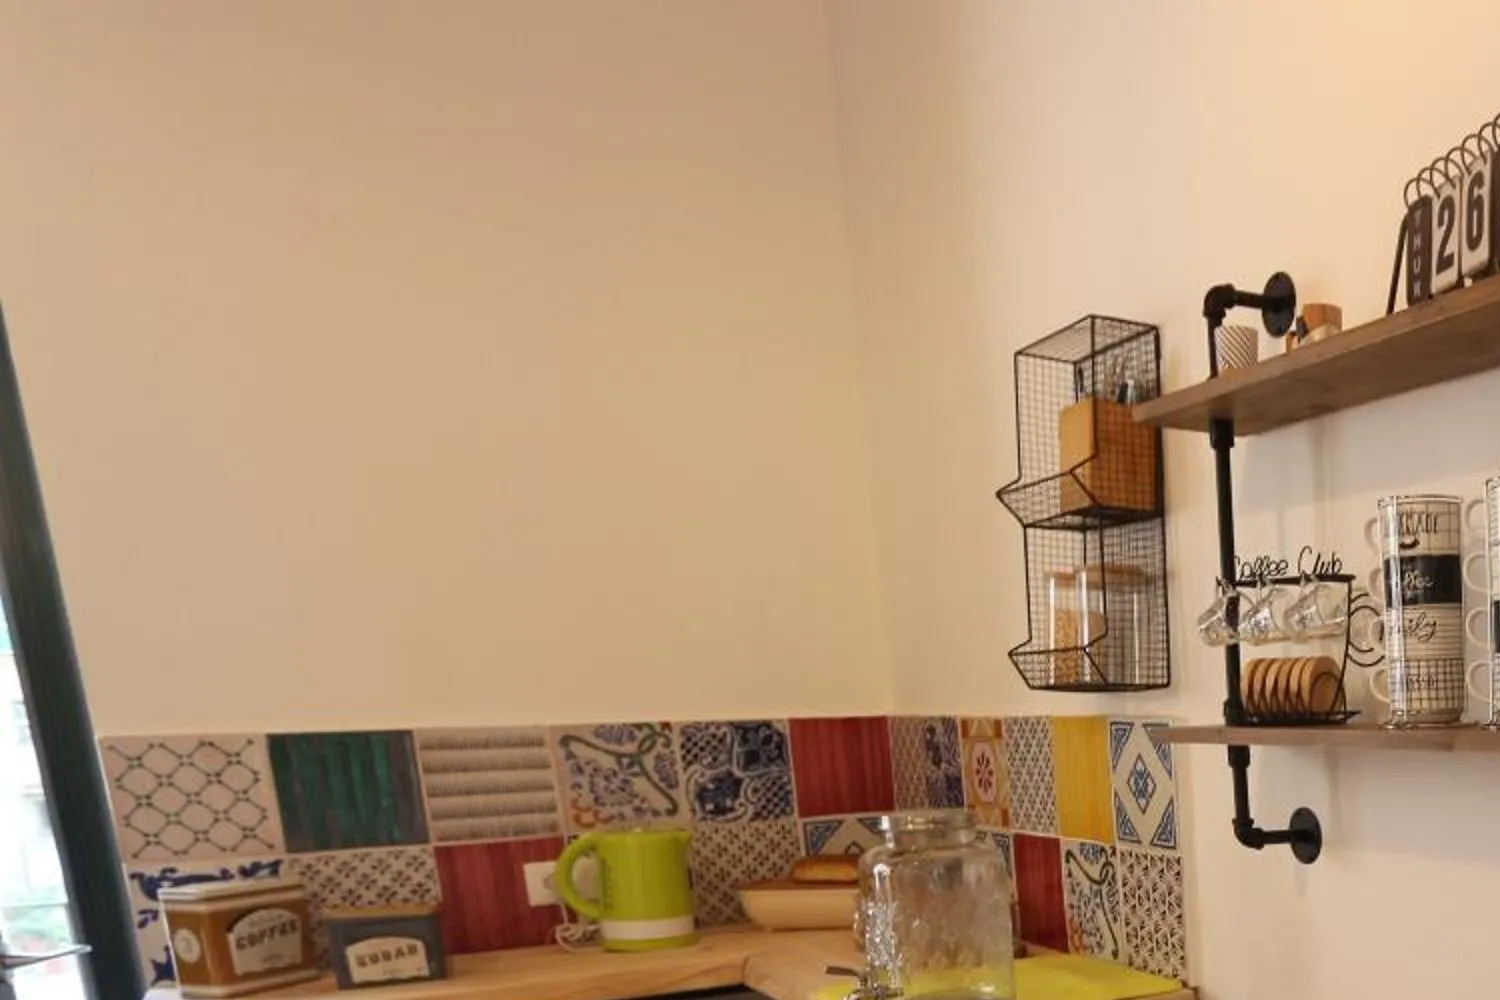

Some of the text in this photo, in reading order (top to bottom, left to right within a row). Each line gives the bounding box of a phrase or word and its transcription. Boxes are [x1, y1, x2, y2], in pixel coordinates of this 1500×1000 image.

[1435, 170, 1486, 276] 26
[1298, 546, 1343, 576] Club
[235, 919, 297, 951] COFFEE
